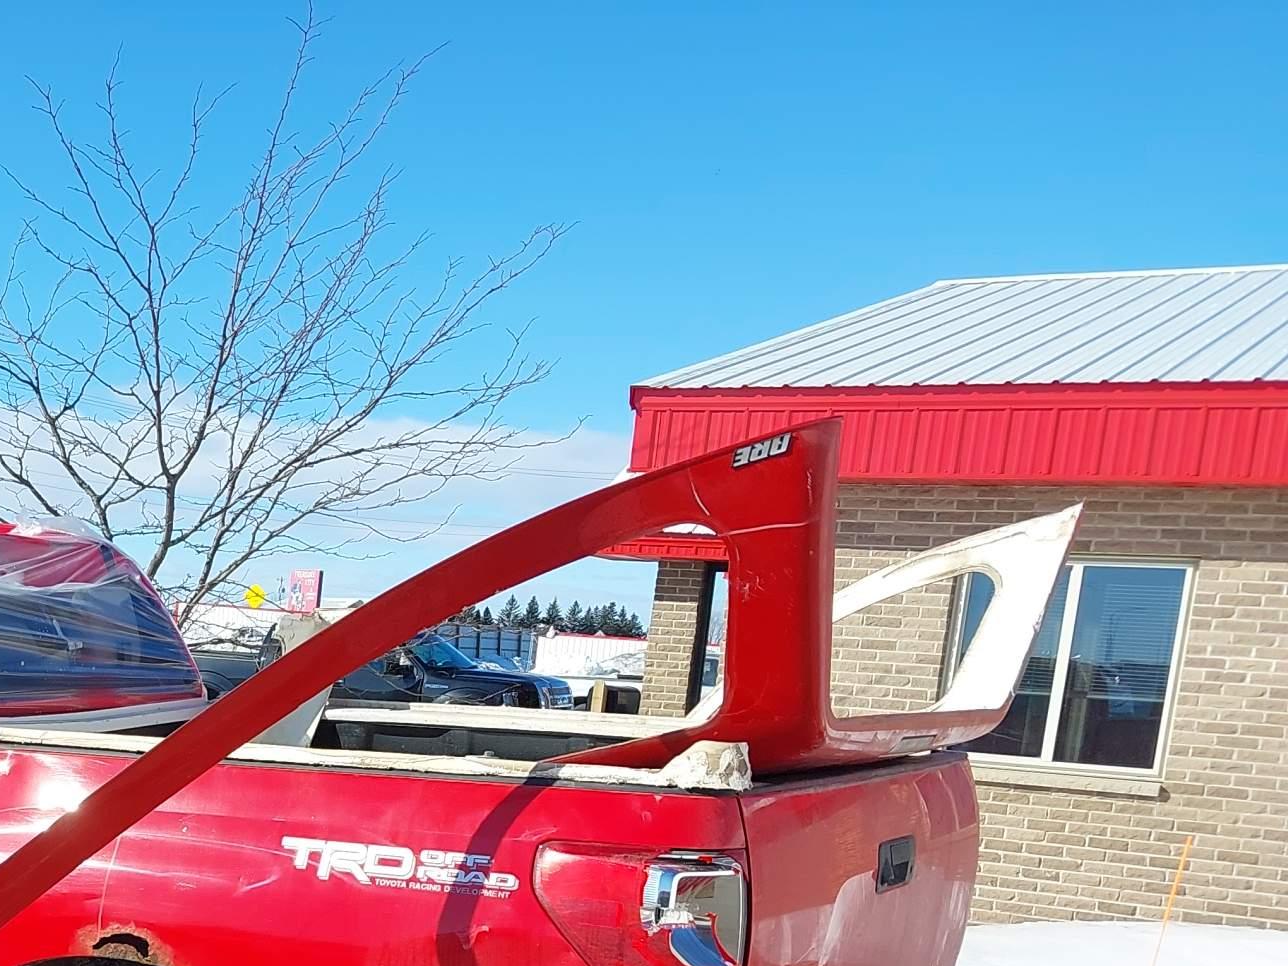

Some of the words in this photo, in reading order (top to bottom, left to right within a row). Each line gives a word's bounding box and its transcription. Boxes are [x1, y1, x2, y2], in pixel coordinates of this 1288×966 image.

[281, 835, 416, 885] TRD
[420, 849, 494, 869] OFF
[374, 878, 407, 889] TOYOTA
[408, 881, 441, 893] RACING
[443, 884, 512, 899] DEVELOPMENT
[416, 866, 520, 891] ROAD
